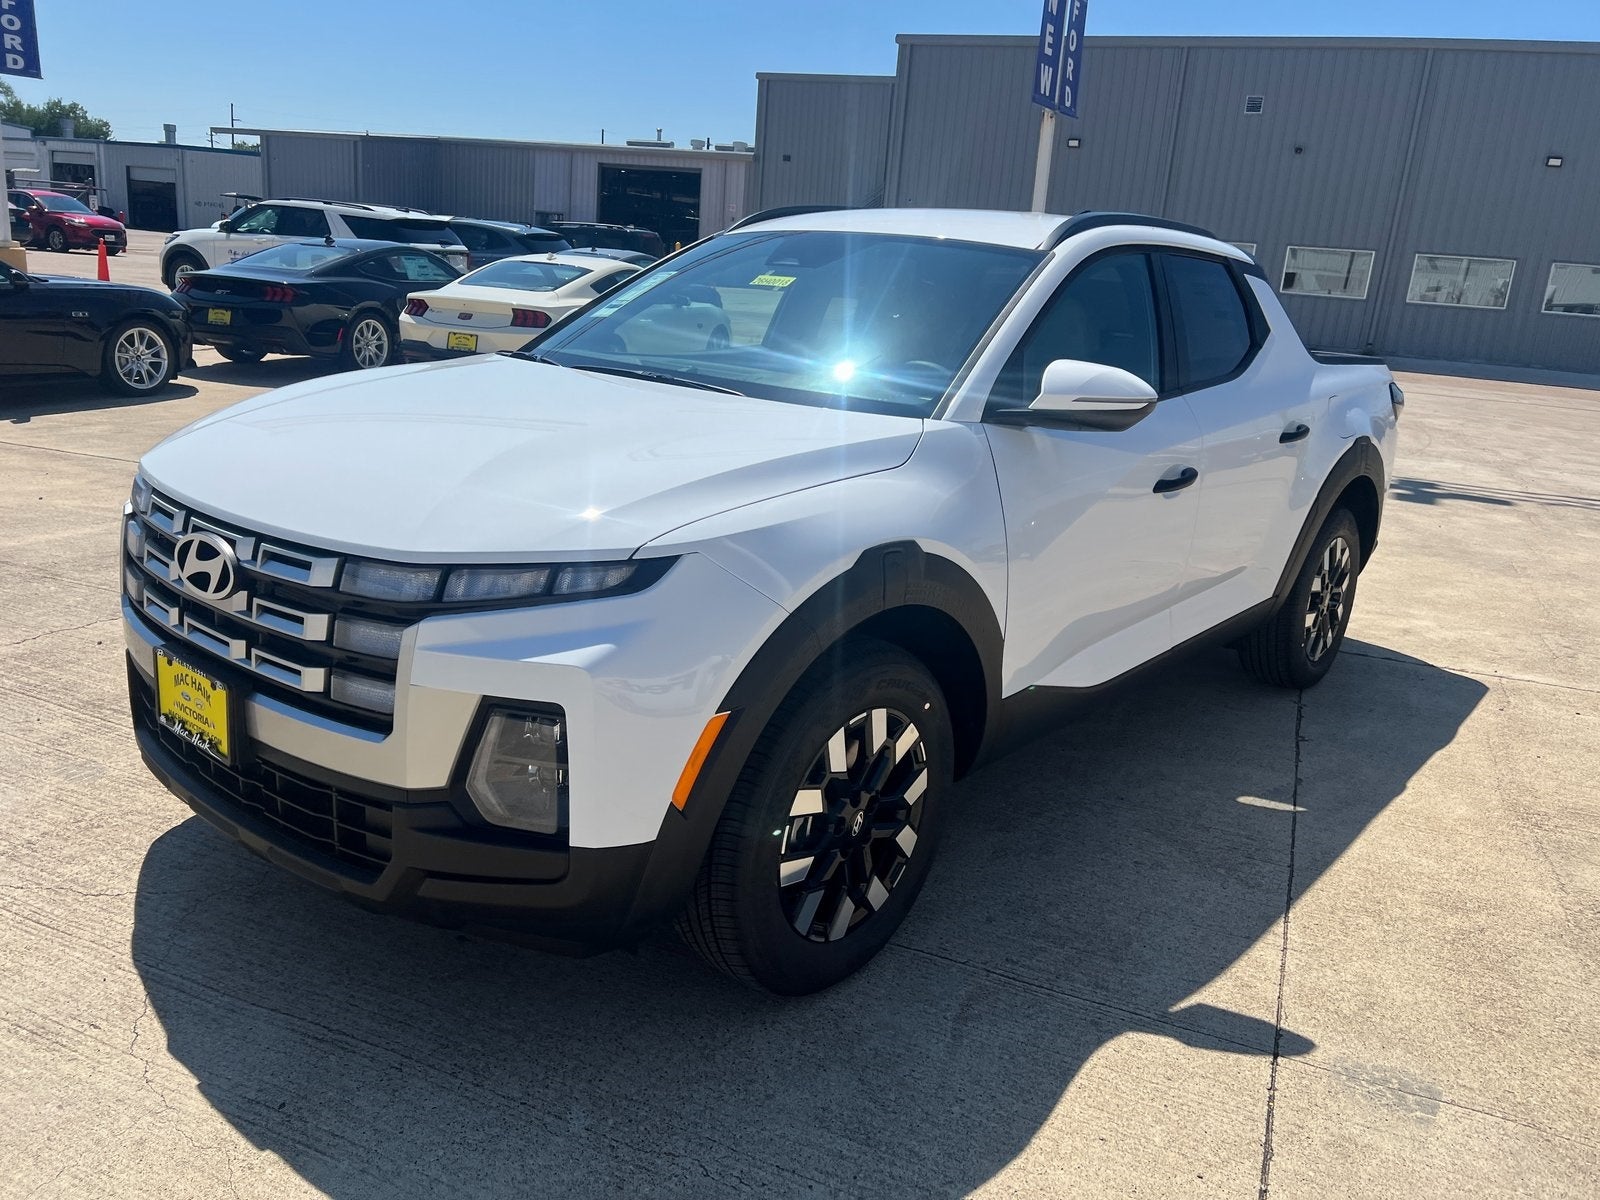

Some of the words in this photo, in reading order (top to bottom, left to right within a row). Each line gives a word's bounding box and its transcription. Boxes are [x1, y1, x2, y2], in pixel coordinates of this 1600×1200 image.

[1065, 0, 1080, 108] FORD
[173, 672, 190, 688] MAC
[190, 675, 212, 708] HAIK
[173, 719, 190, 739] Mac
[180, 702, 211, 728] VICTORIA
